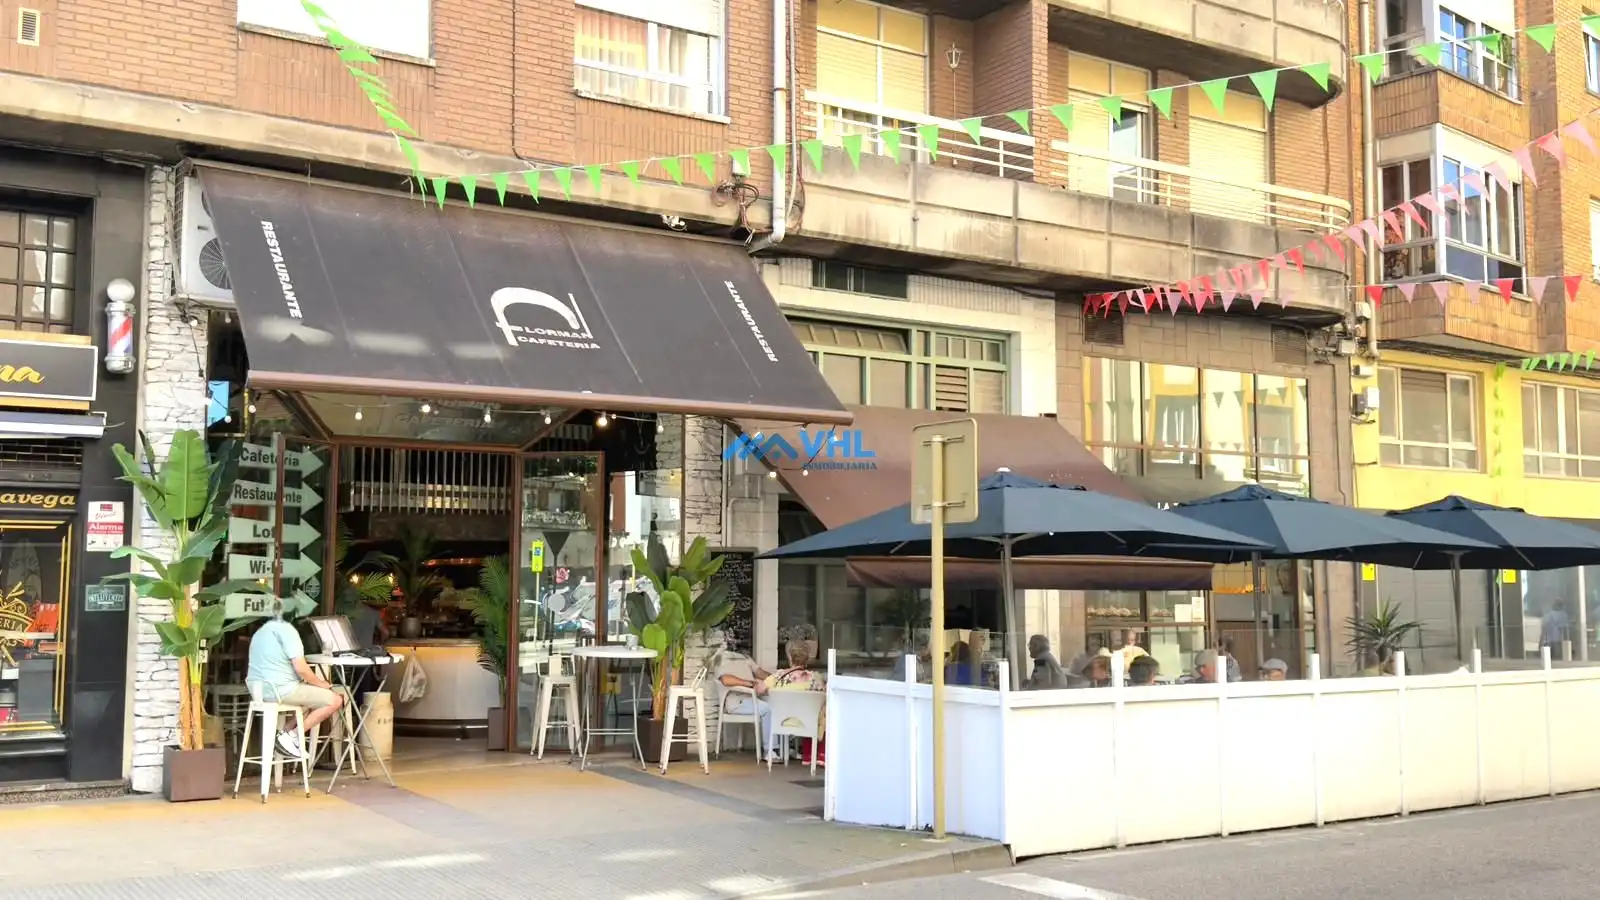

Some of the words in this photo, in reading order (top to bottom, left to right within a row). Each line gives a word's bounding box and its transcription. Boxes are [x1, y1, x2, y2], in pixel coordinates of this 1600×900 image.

[260, 220, 303, 319] RESTAURANTE
[517, 336, 601, 349] CAFETERIA
[724, 280, 779, 362] RESTAURANTE
[234, 483, 303, 503] Restaunte
